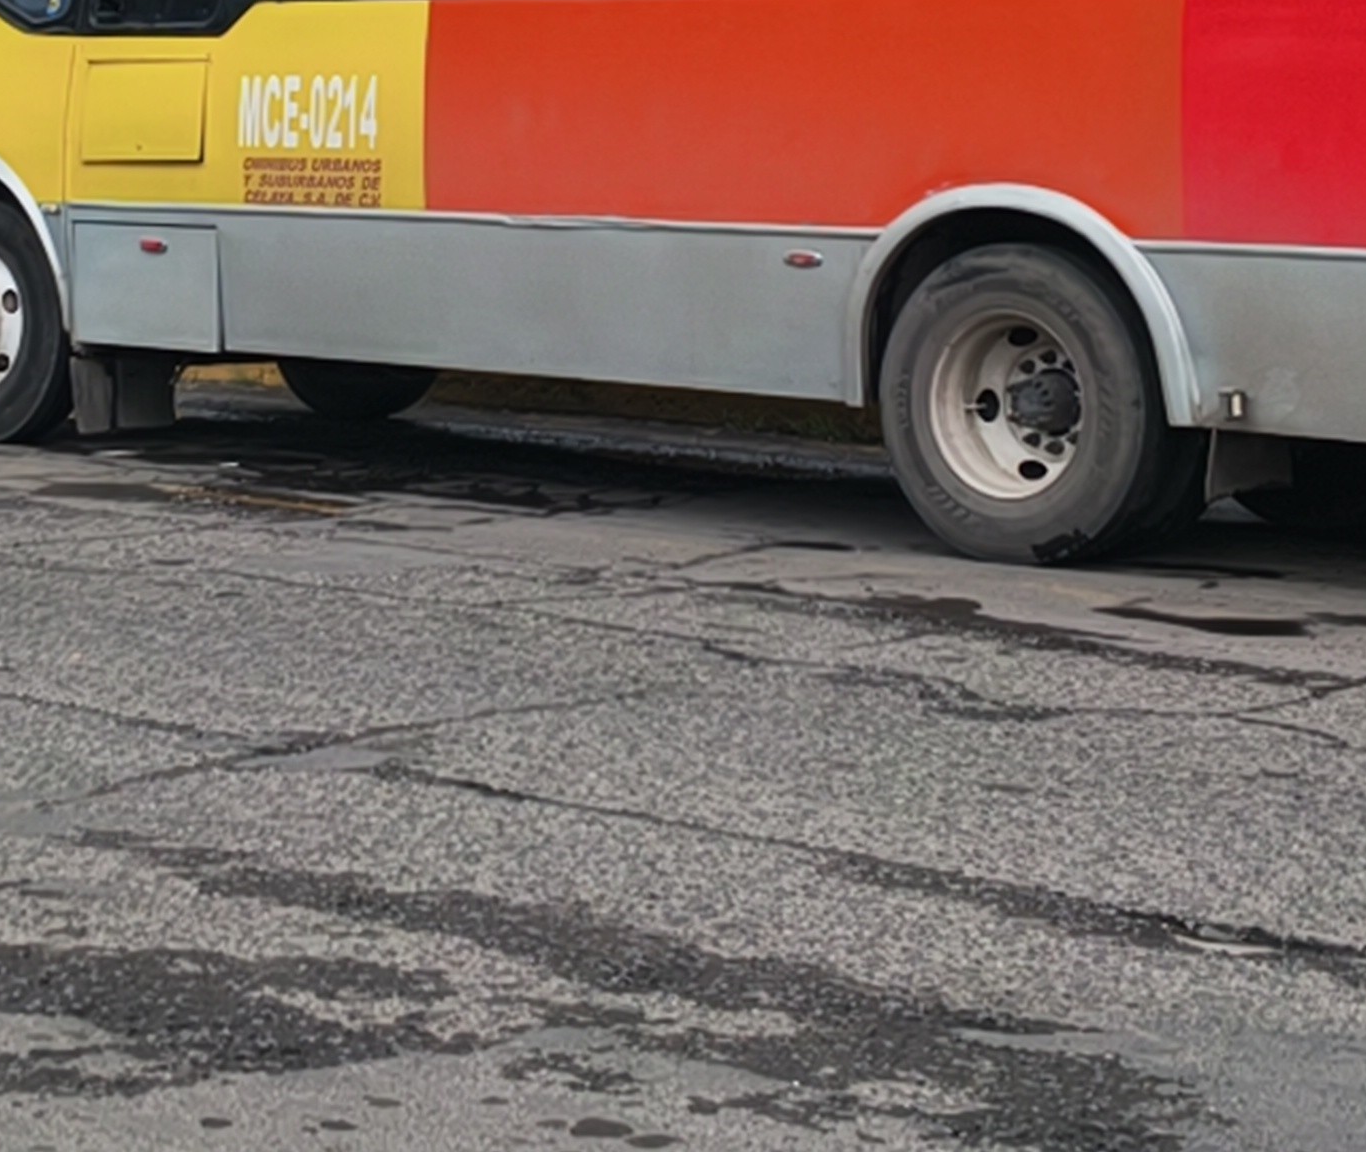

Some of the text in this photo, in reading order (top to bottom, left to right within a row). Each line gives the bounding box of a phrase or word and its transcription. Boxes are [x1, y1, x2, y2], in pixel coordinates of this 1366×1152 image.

[237, 74, 379, 149] MCE-0214
[311, 157, 383, 173] URBANOS
[243, 173, 382, 191] Y SUBURBANOS DE
[335, 192, 354, 206] DE
